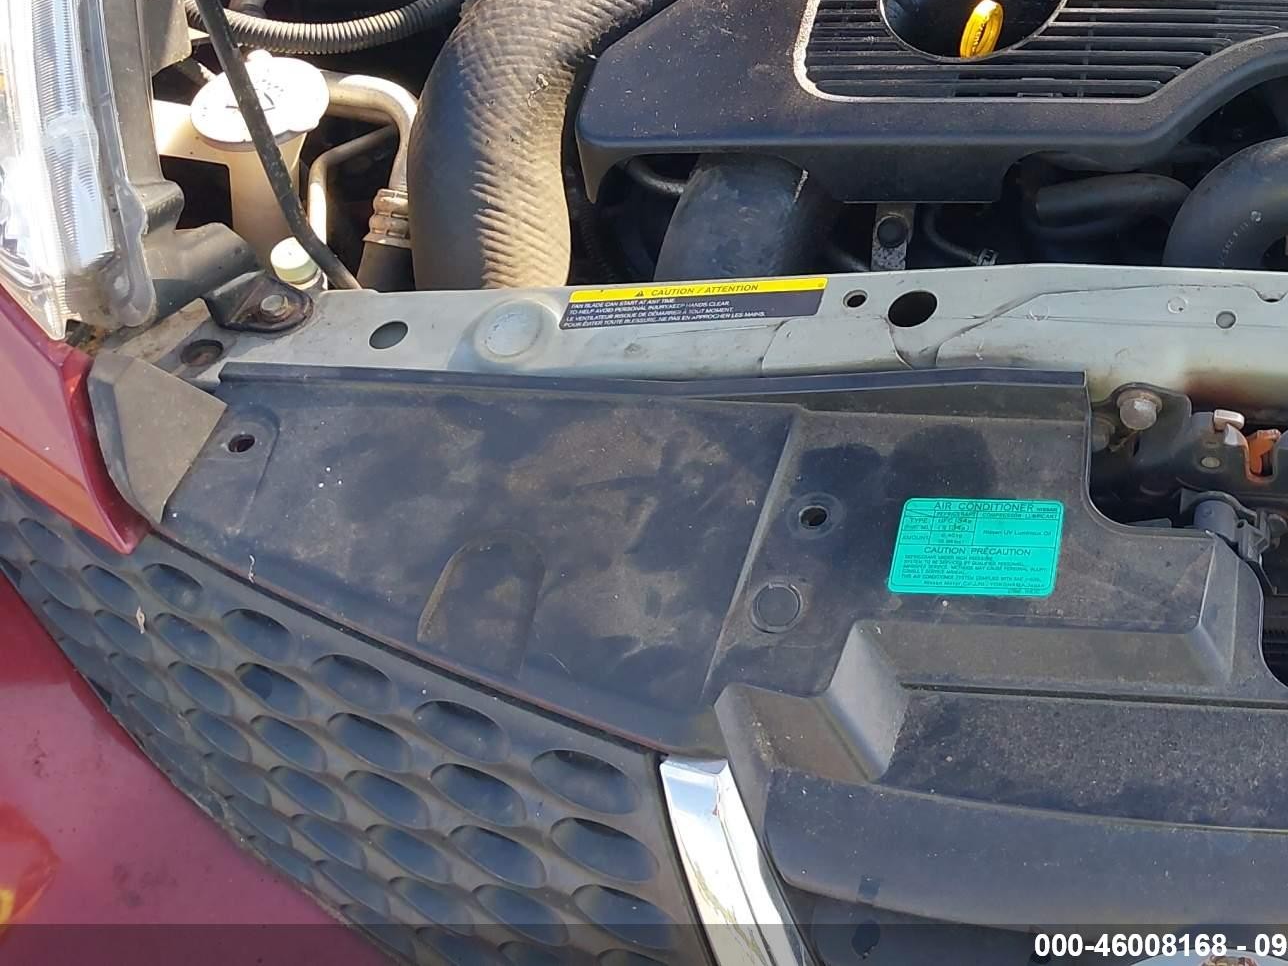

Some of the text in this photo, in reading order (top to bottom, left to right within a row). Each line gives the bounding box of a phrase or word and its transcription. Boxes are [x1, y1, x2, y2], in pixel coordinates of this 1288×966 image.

[651, 287, 695, 297] CAUTION
[704, 283, 759, 294] ATTENTION
[614, 305, 646, 313] PERSONAL
[934, 502, 952, 511] AIR
[958, 502, 1034, 512] CONDITIONER
[924, 546, 1031, 556] CAUTION PRÉCAUTION
